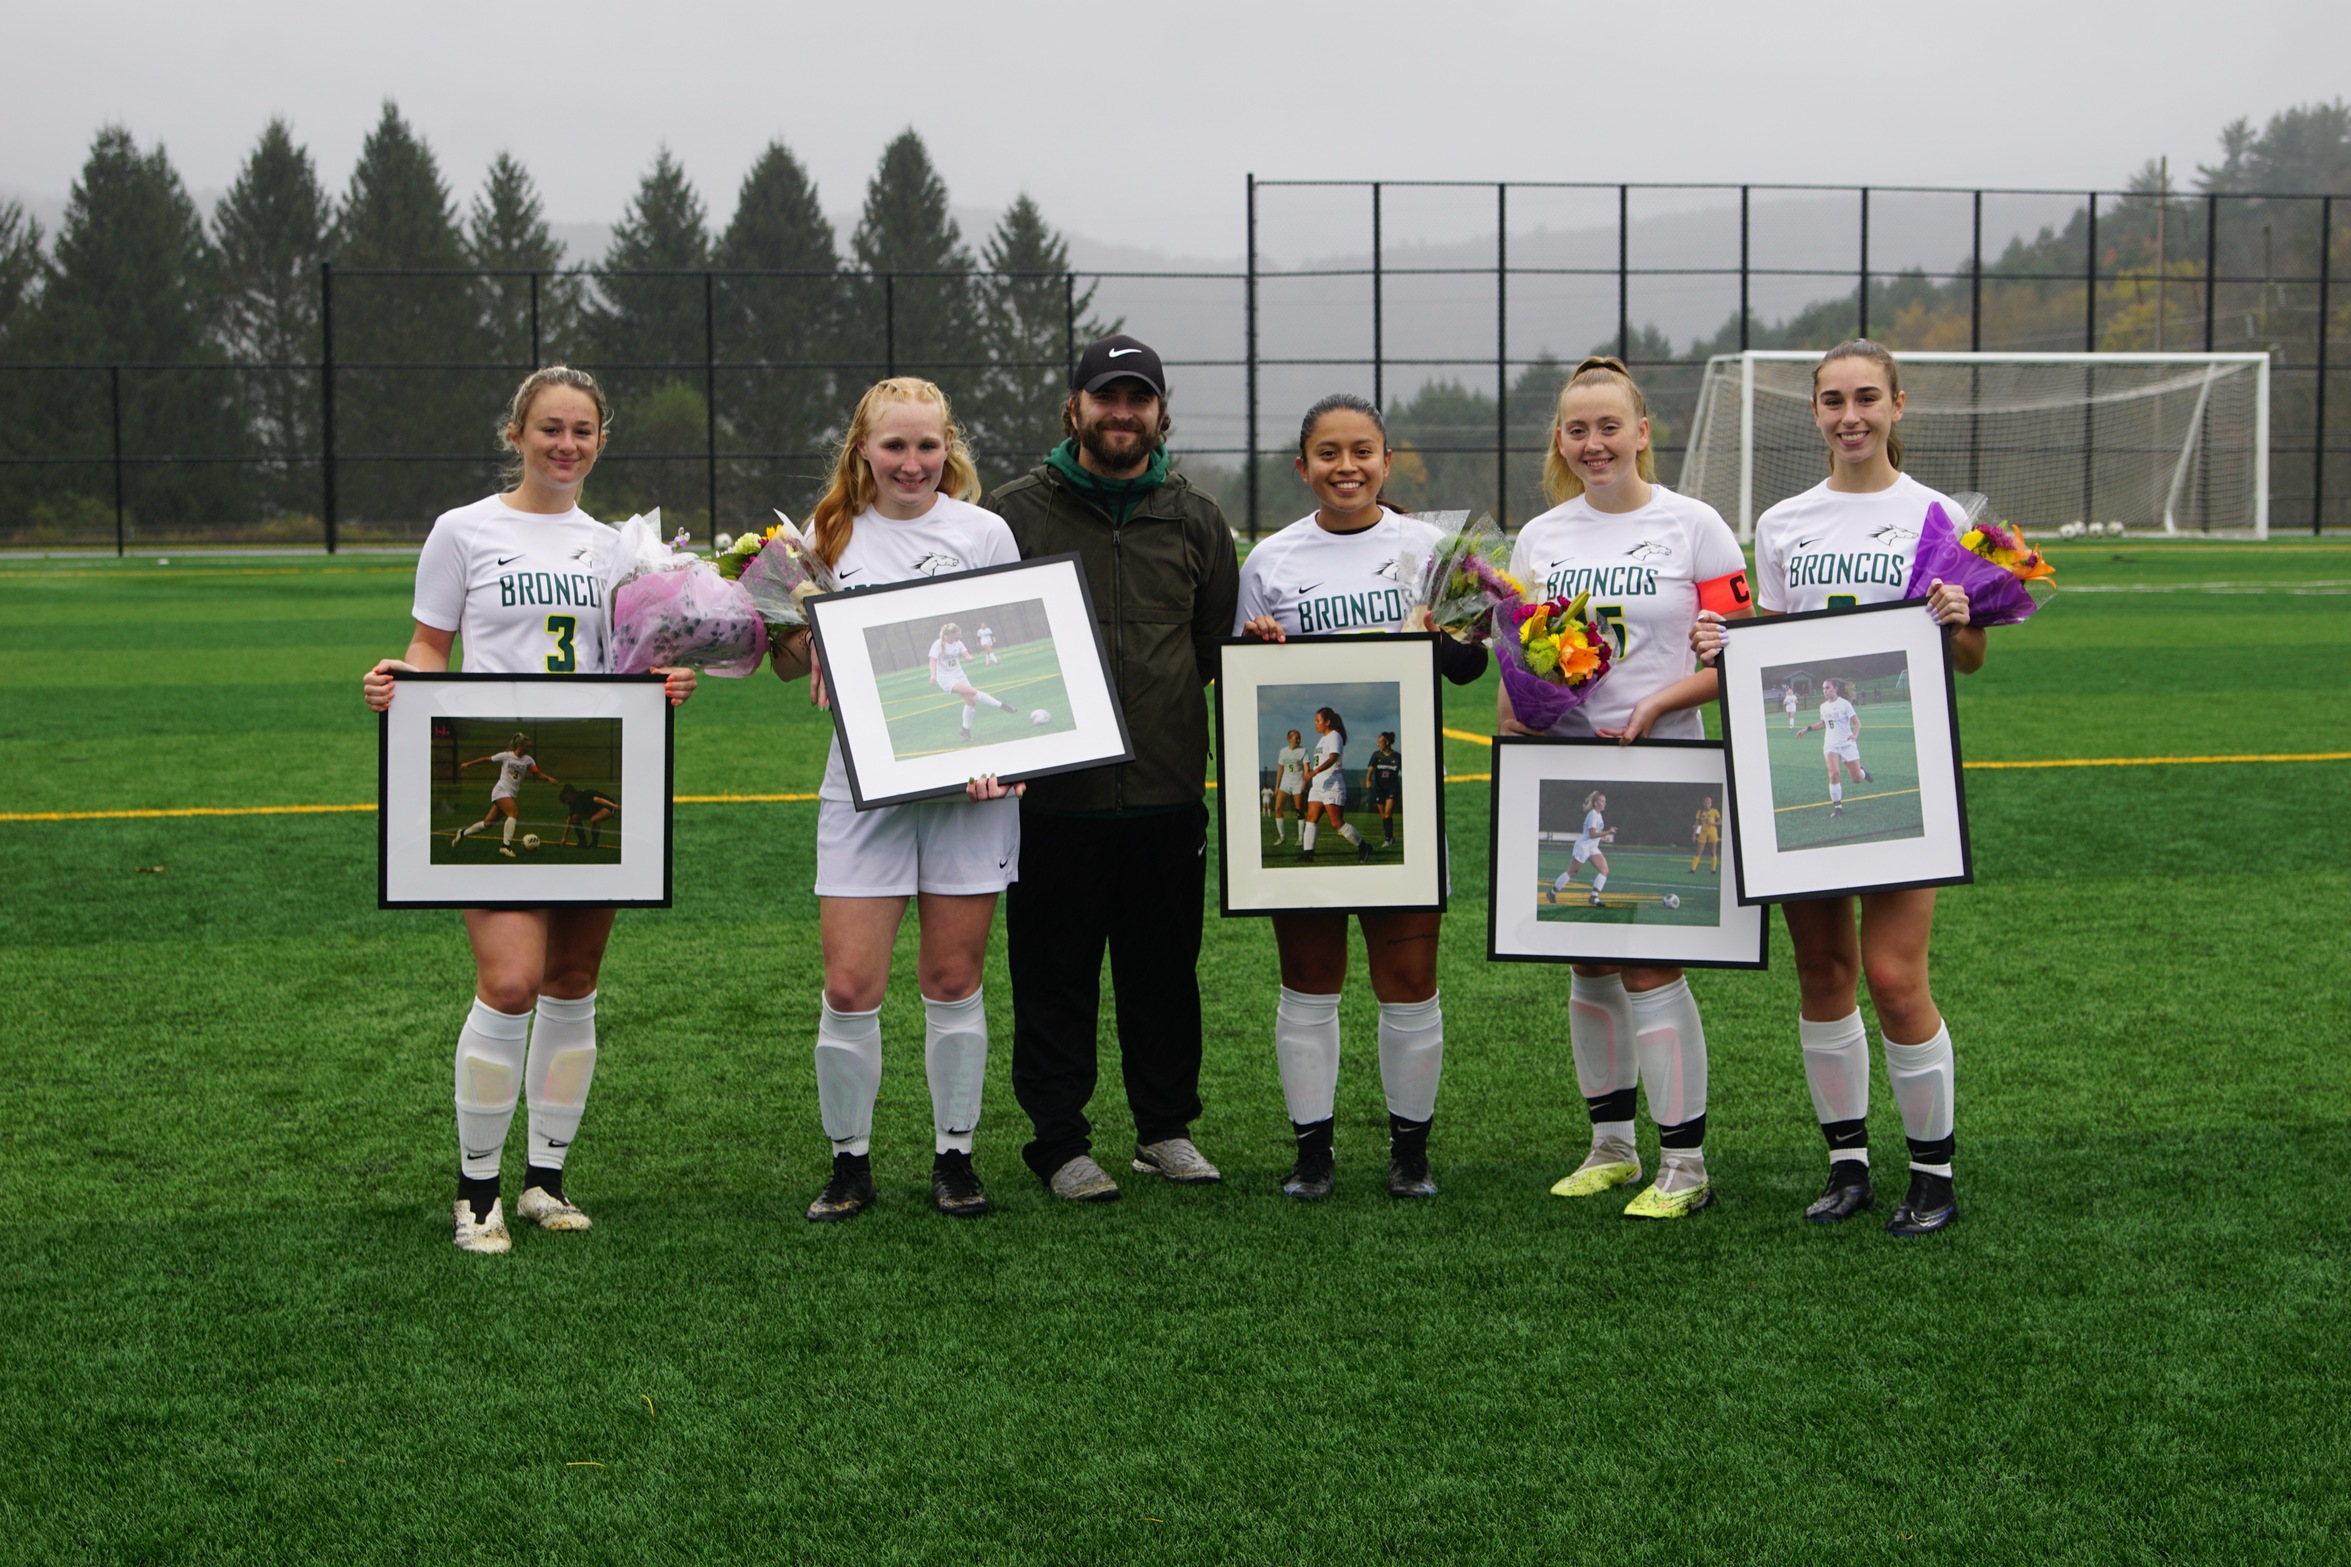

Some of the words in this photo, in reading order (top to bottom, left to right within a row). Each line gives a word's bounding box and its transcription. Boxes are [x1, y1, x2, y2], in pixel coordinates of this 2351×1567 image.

[1547, 566, 1659, 601] BRONCOS
[1789, 553, 1905, 589] BRONCOS
[1729, 574, 1750, 604] C
[545, 614, 578, 674] 3
